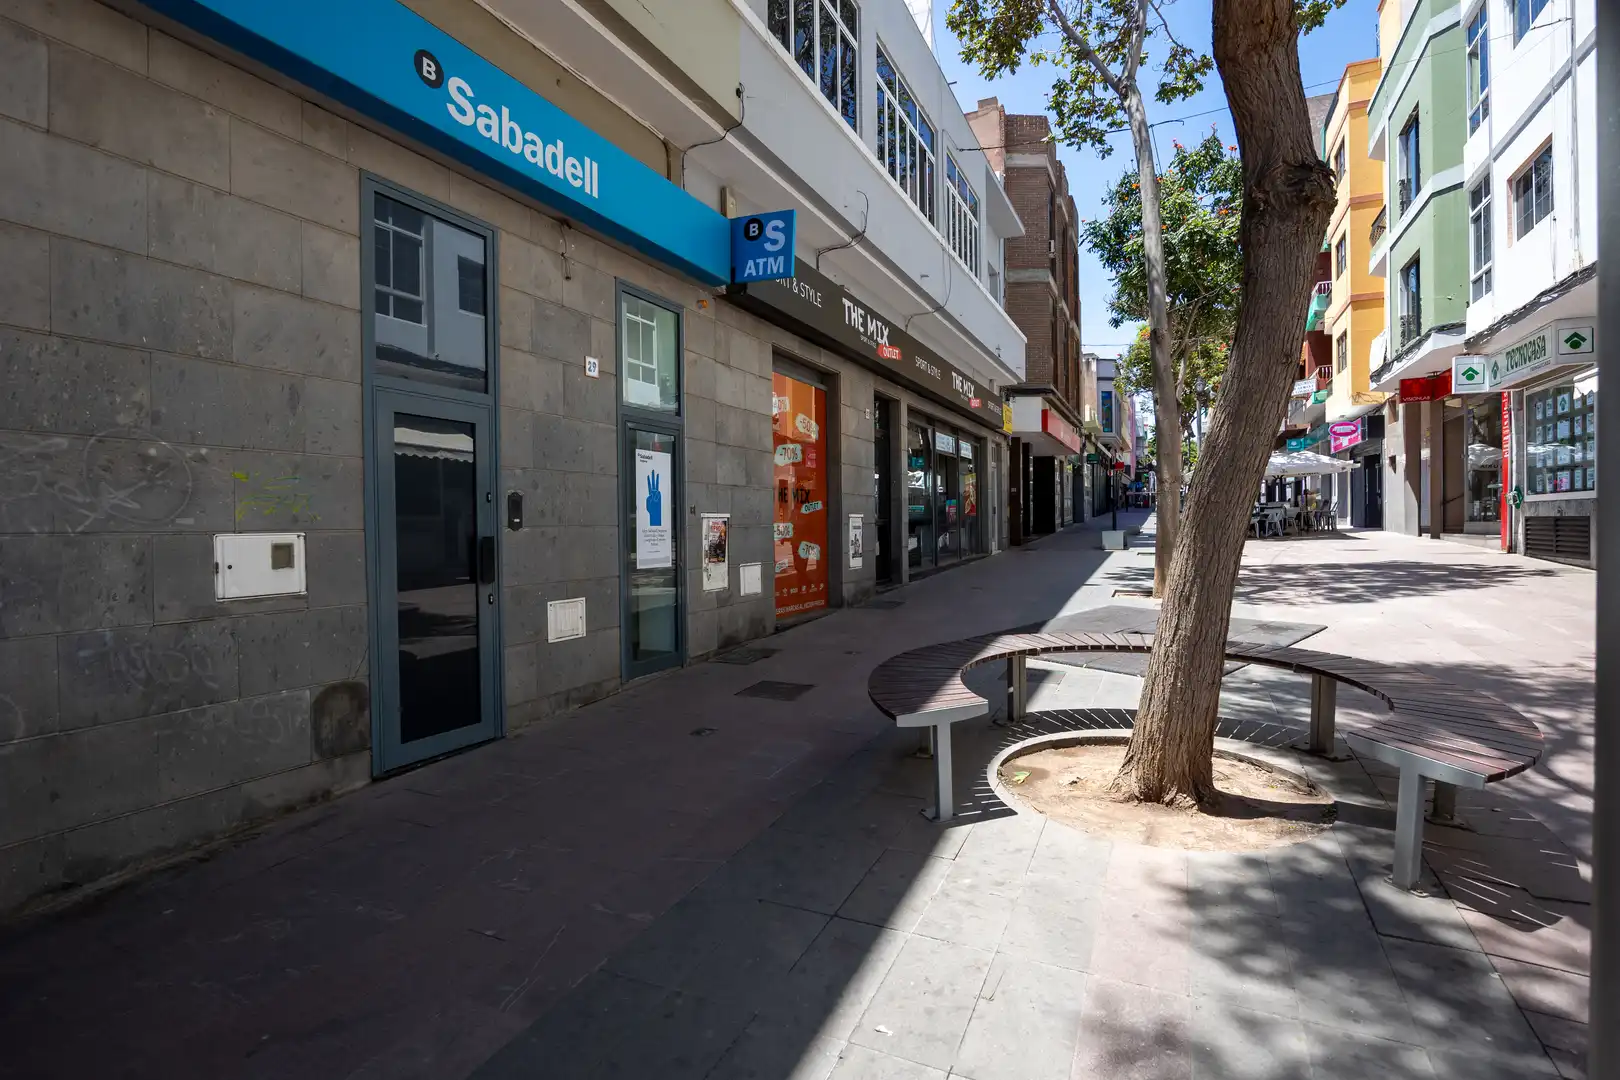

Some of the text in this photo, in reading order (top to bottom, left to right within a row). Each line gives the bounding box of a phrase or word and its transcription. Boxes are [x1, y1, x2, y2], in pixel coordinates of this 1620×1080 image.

[422, 56, 599, 199] B Sabadell
[749, 219, 786, 252] B S
[743, 255, 784, 278] ATM
[792, 277, 799, 294] &
[799, 282, 822, 308] STYLE
[842, 297, 890, 347] THE MIX
[882, 347, 900, 360] OUTLET
[915, 355, 928, 371] SPORT
[1505, 334, 1546, 372] TECNOCASA
[587, 360, 597, 373] 29
[951, 371, 975, 399] THE MIX
[779, 447, 798, 460] -70%
[804, 502, 820, 512] OUTLET
[774, 525, 790, 536] -50%
